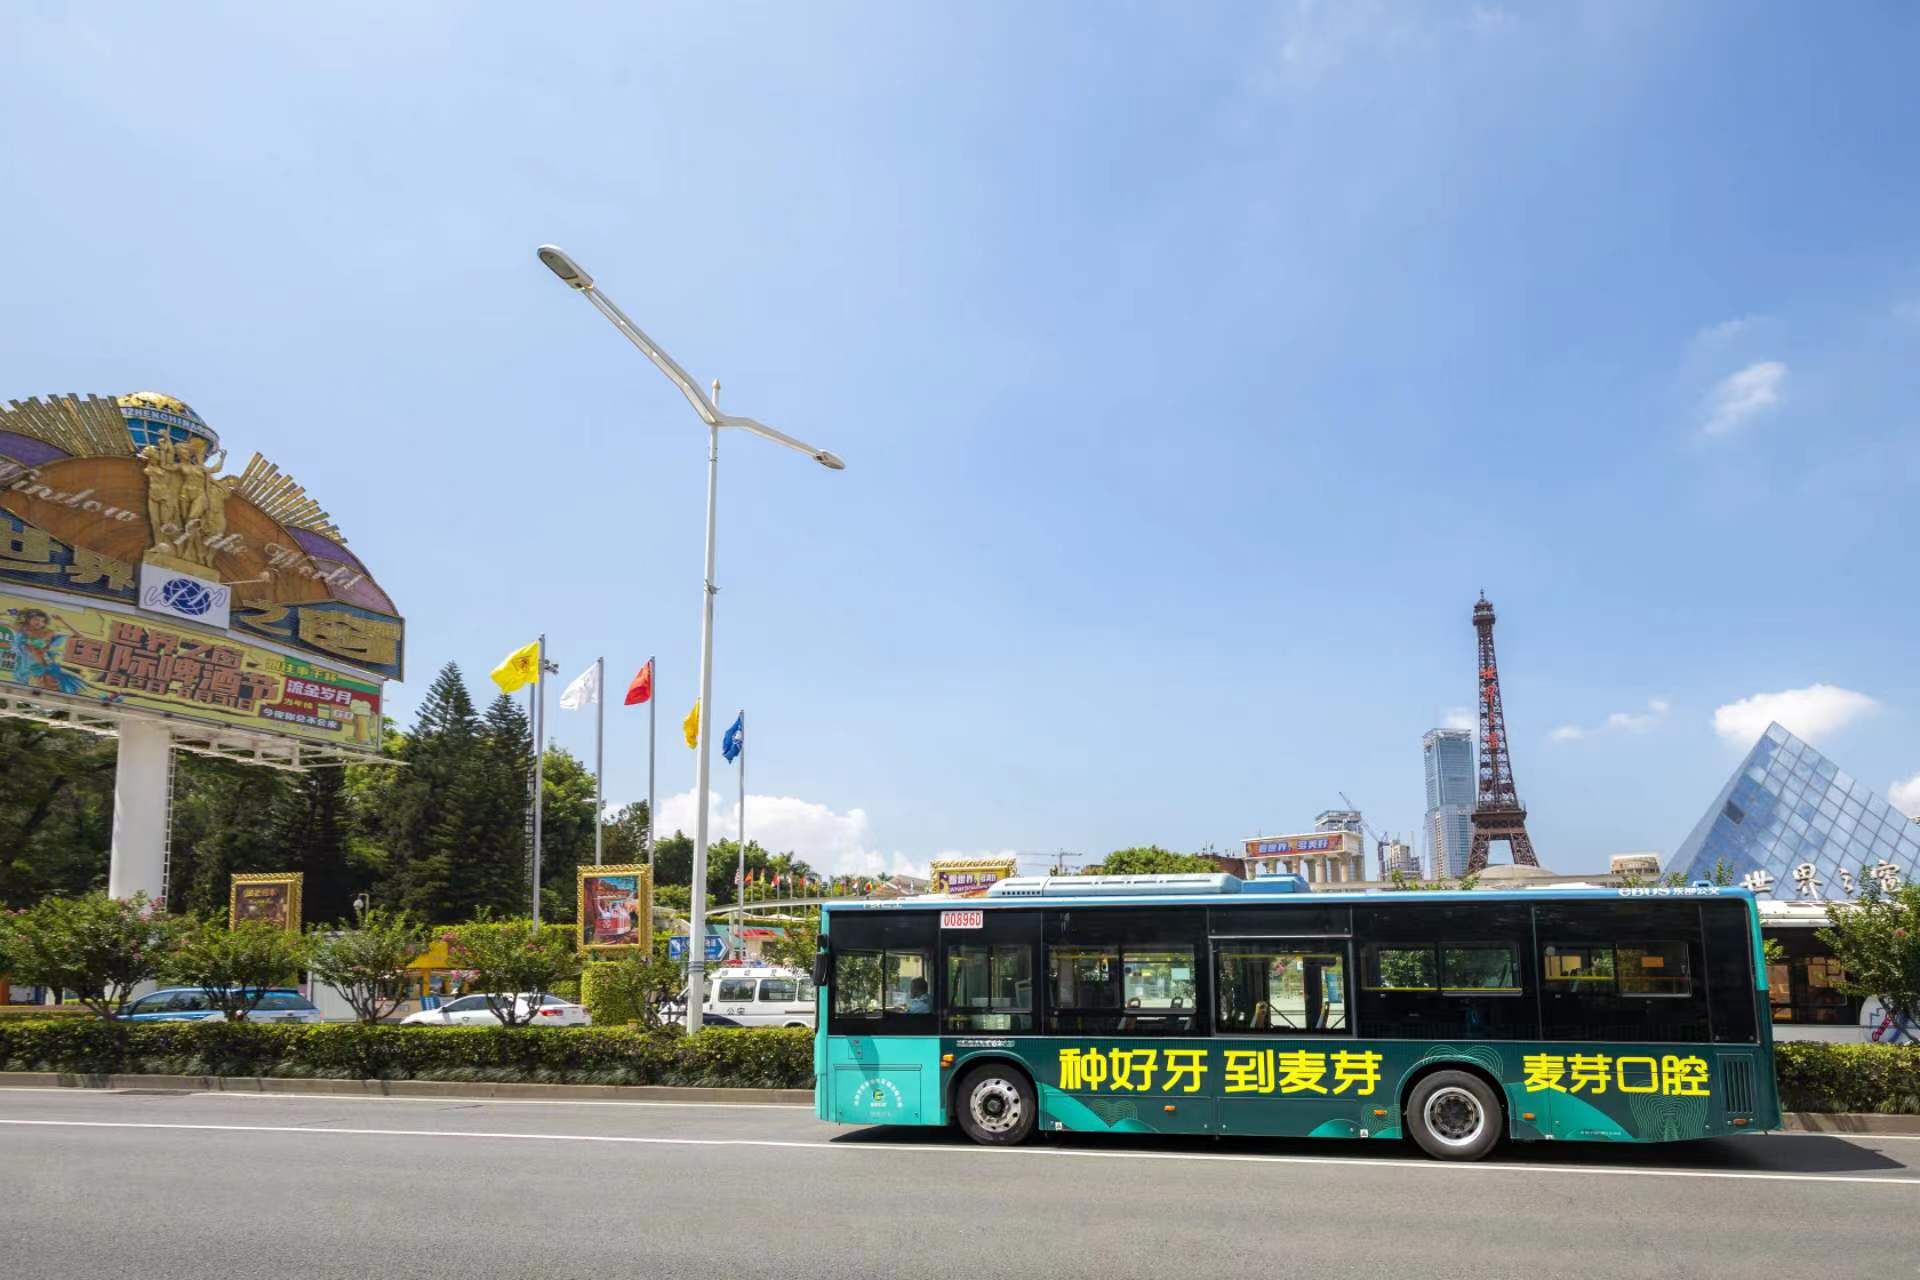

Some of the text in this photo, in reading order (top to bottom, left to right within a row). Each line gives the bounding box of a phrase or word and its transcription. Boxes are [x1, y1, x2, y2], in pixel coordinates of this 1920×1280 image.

[111, 620, 246, 670] 世界之窗
[64, 637, 281, 702] 国际啤酒节
[285, 679, 352, 705] 流金岁月
[1740, 859, 1901, 898] 世界之窗
[943, 912, 981, 926] 008960
[1059, 1047, 1383, 1096] 种好牙 到麦芽
[1522, 1053, 1710, 1096] 麦芽口腔
